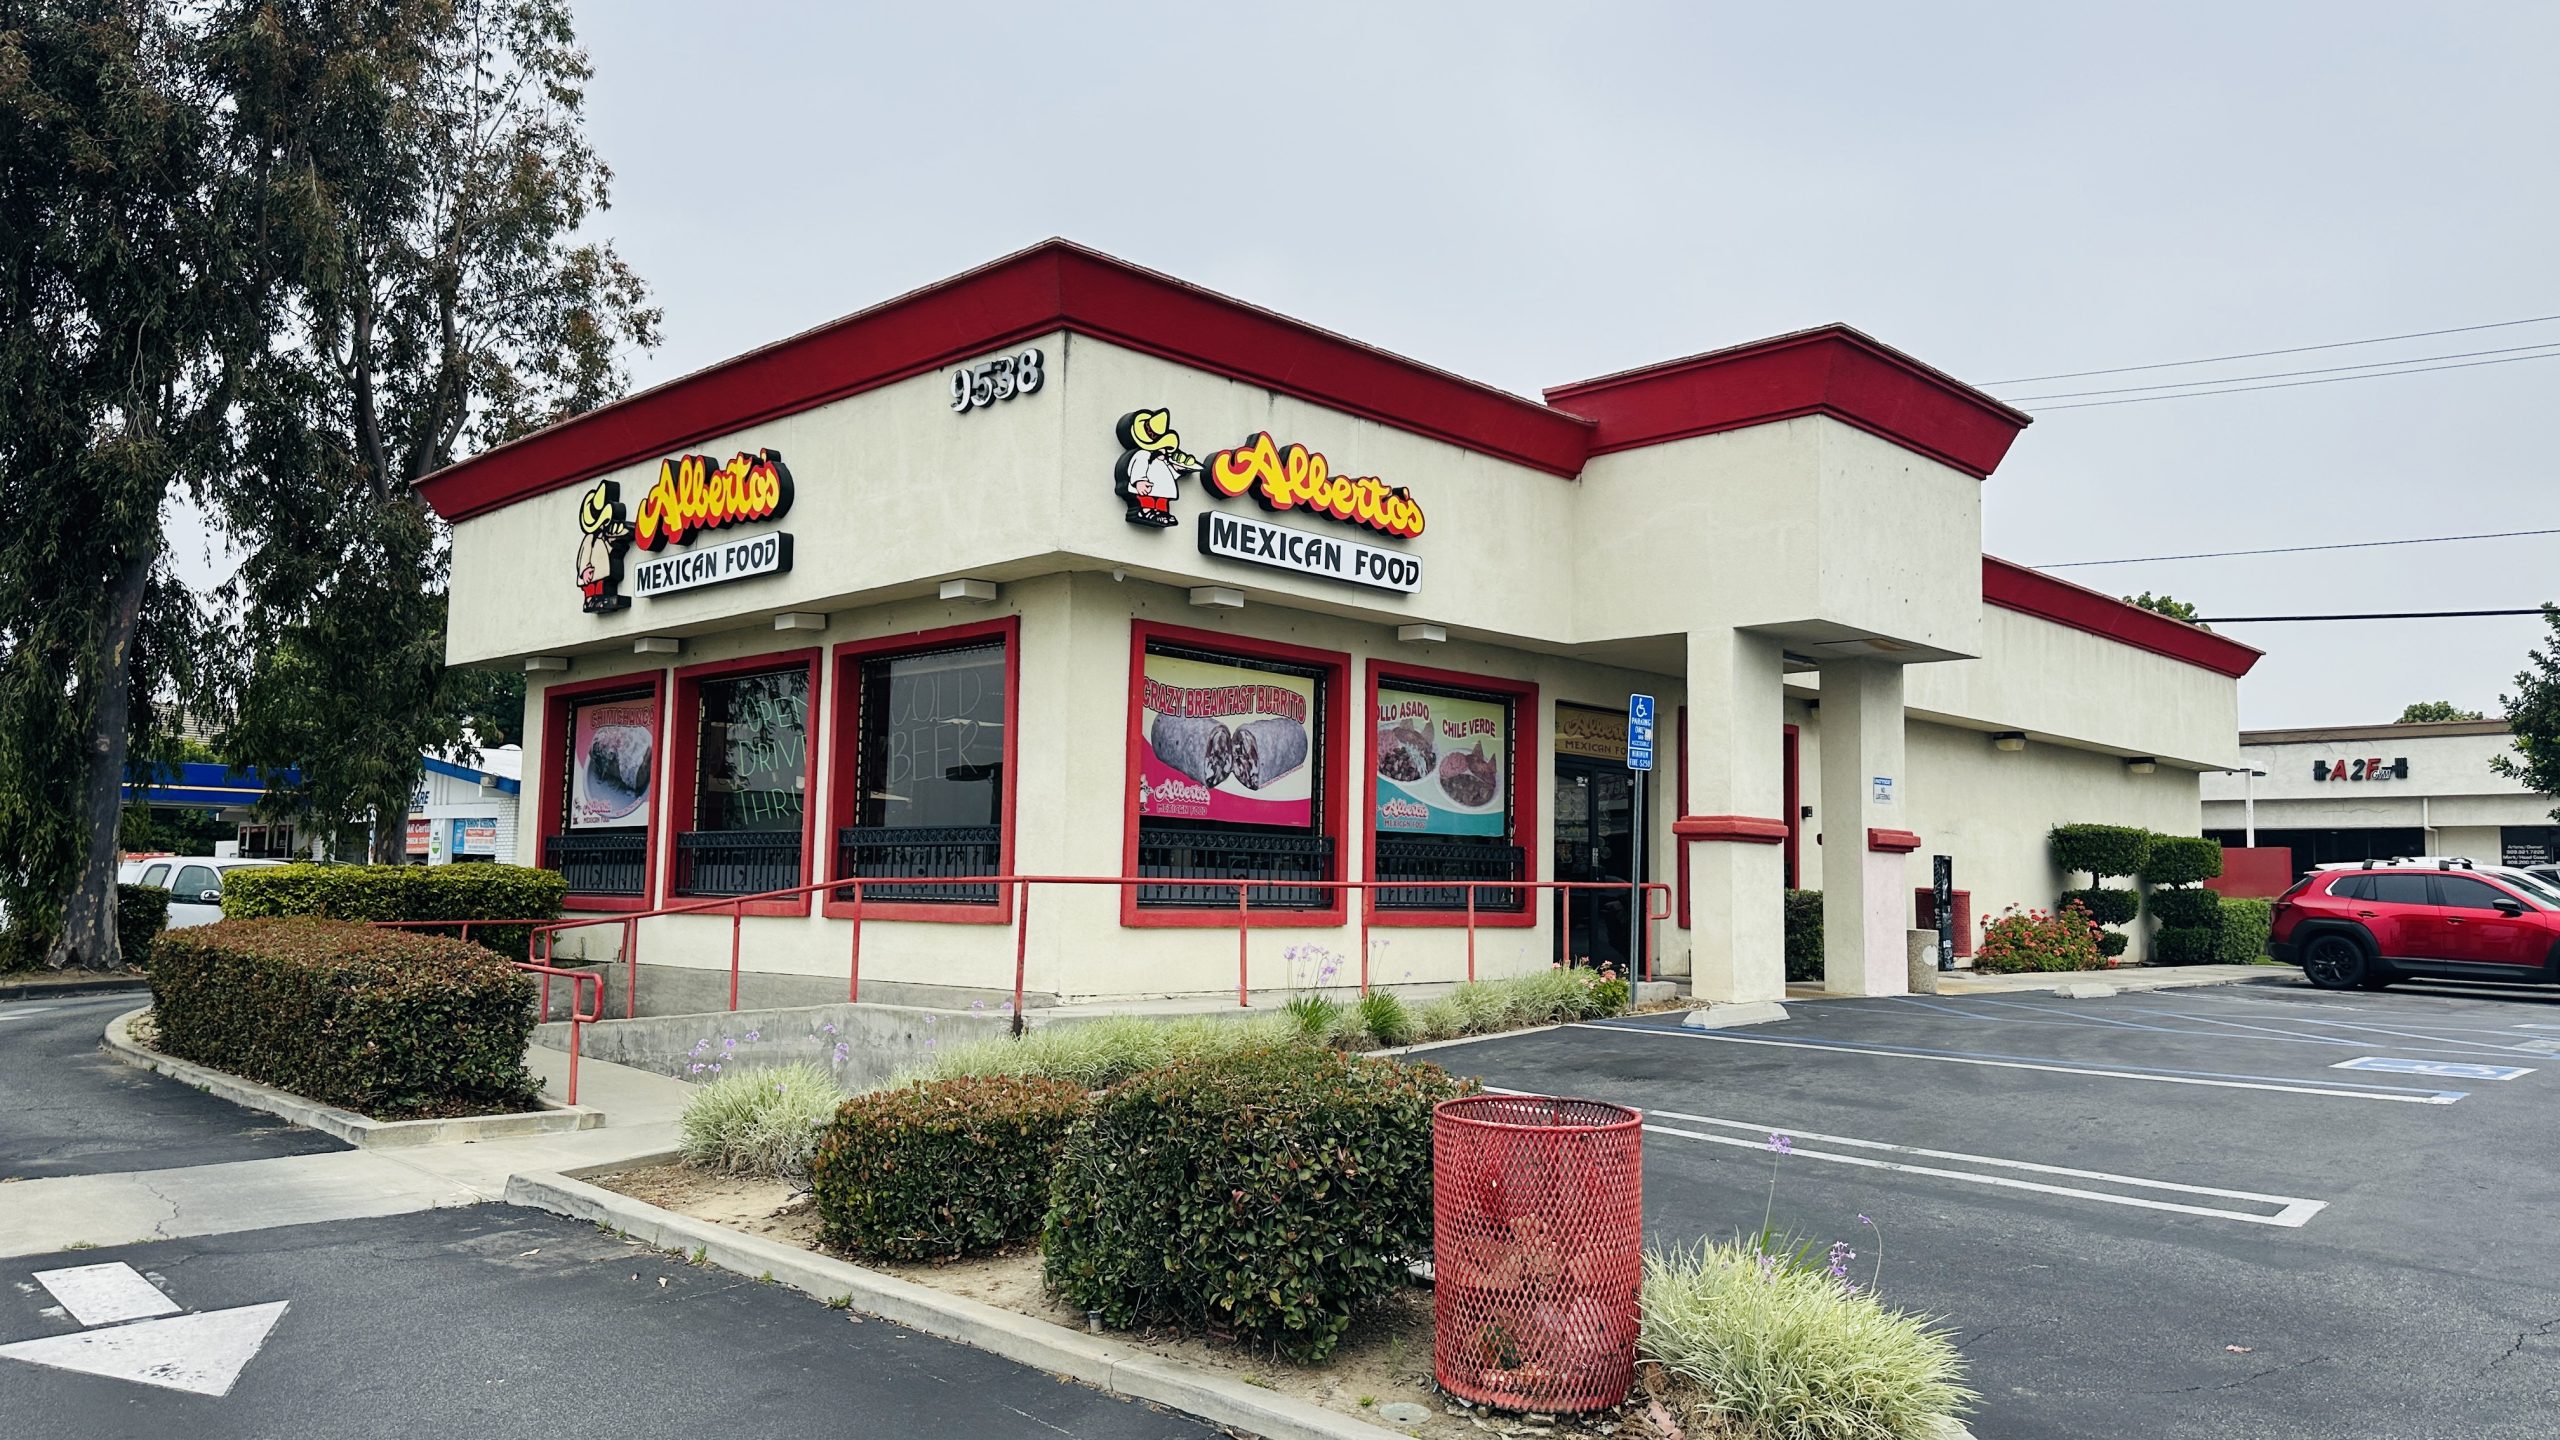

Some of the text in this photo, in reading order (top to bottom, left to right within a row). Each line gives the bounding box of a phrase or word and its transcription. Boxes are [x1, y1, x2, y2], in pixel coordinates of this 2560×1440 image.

[950, 348, 1043, 412] 9538
[635, 448, 781, 550] Alberto's
[1212, 432, 1425, 537] Alberto's
[637, 538, 776, 592] MEXICAN FOOD
[1213, 517, 1419, 586] MEXICAN FOOD
[890, 669, 981, 726] COLD
[1143, 676, 1307, 724] CRAZY BREAKFAST BURRITO
[1400, 701, 1430, 721] ASADO
[1631, 718, 1651, 726] PARKING
[891, 721, 978, 783] BEER
[1442, 718, 1496, 738] CHILE VERDE
[1565, 740, 1626, 756] MEXICAN FO
